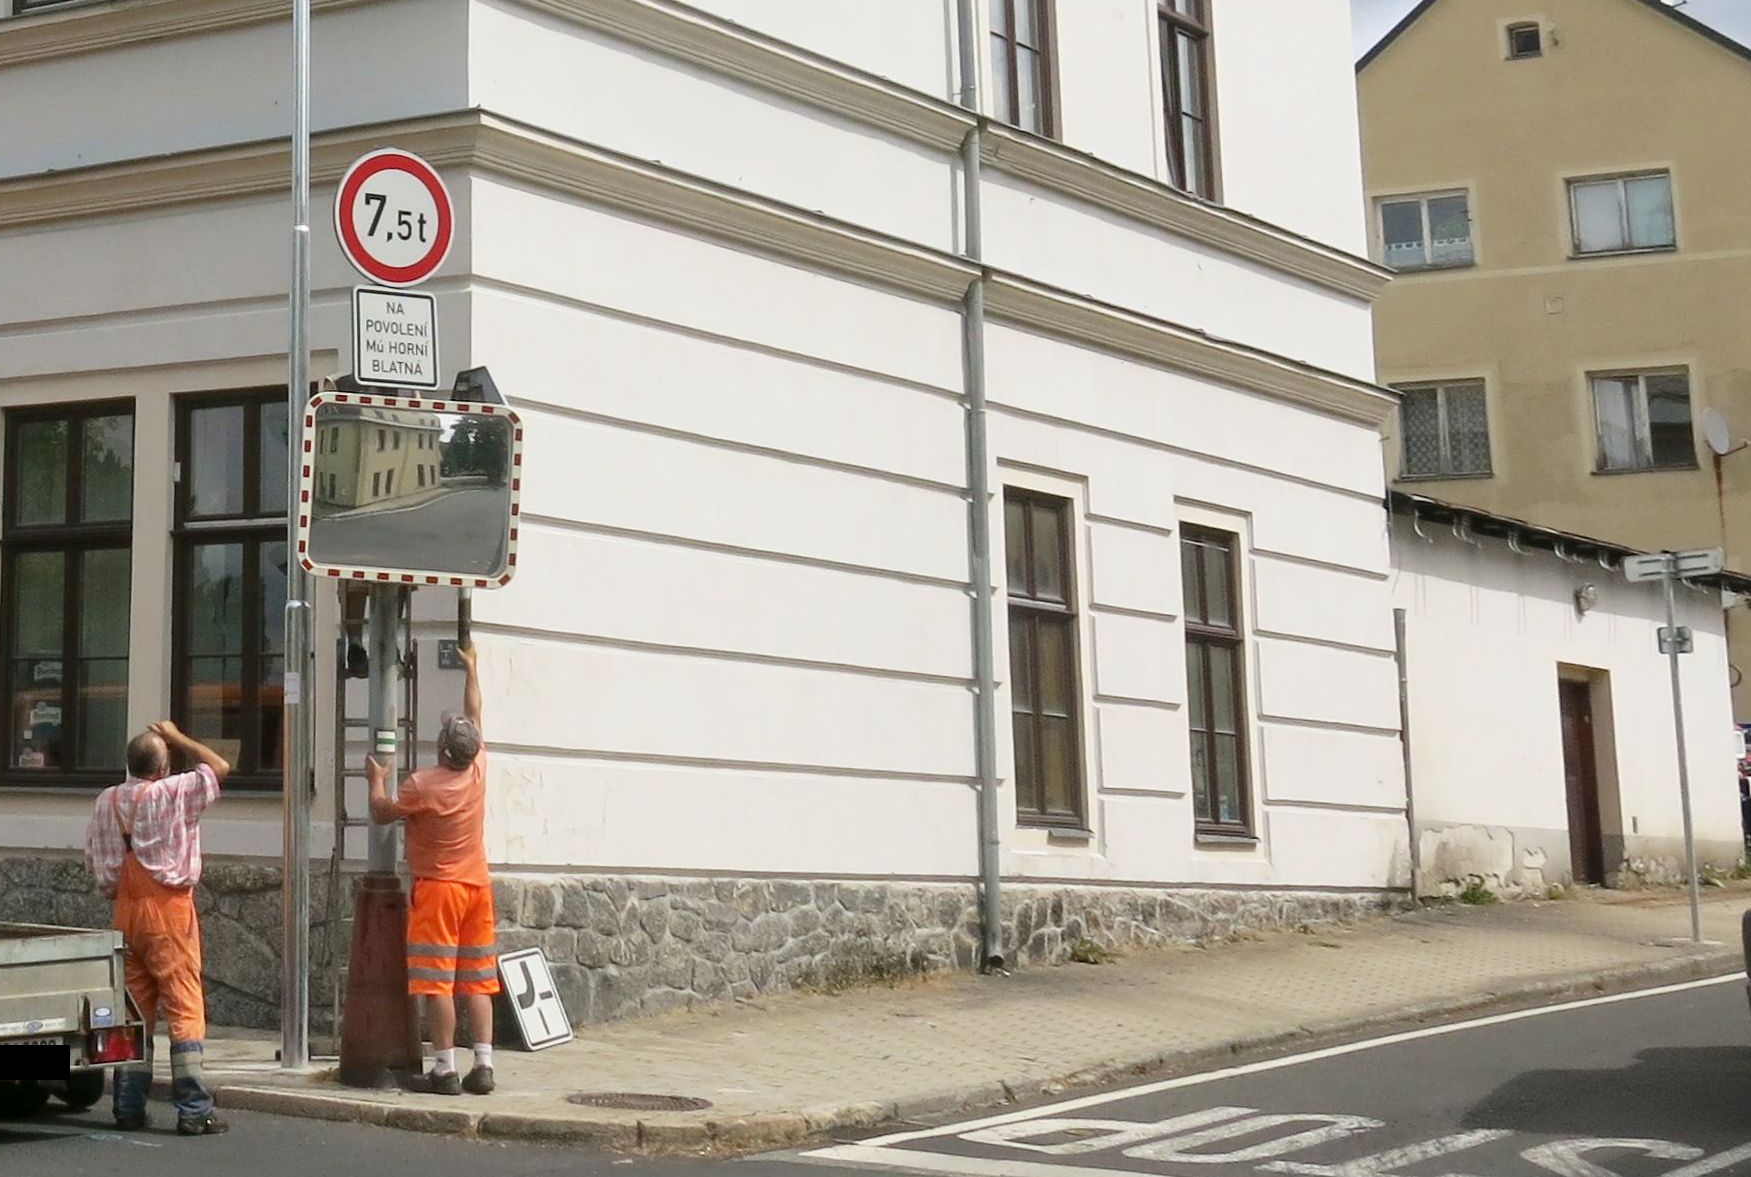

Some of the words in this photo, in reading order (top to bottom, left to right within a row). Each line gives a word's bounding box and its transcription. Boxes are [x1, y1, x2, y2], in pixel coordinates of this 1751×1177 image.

[386, 301, 405, 315] NA
[365, 319, 428, 337] POVOLENÍ
[389, 340, 429, 357] HORNÍ
